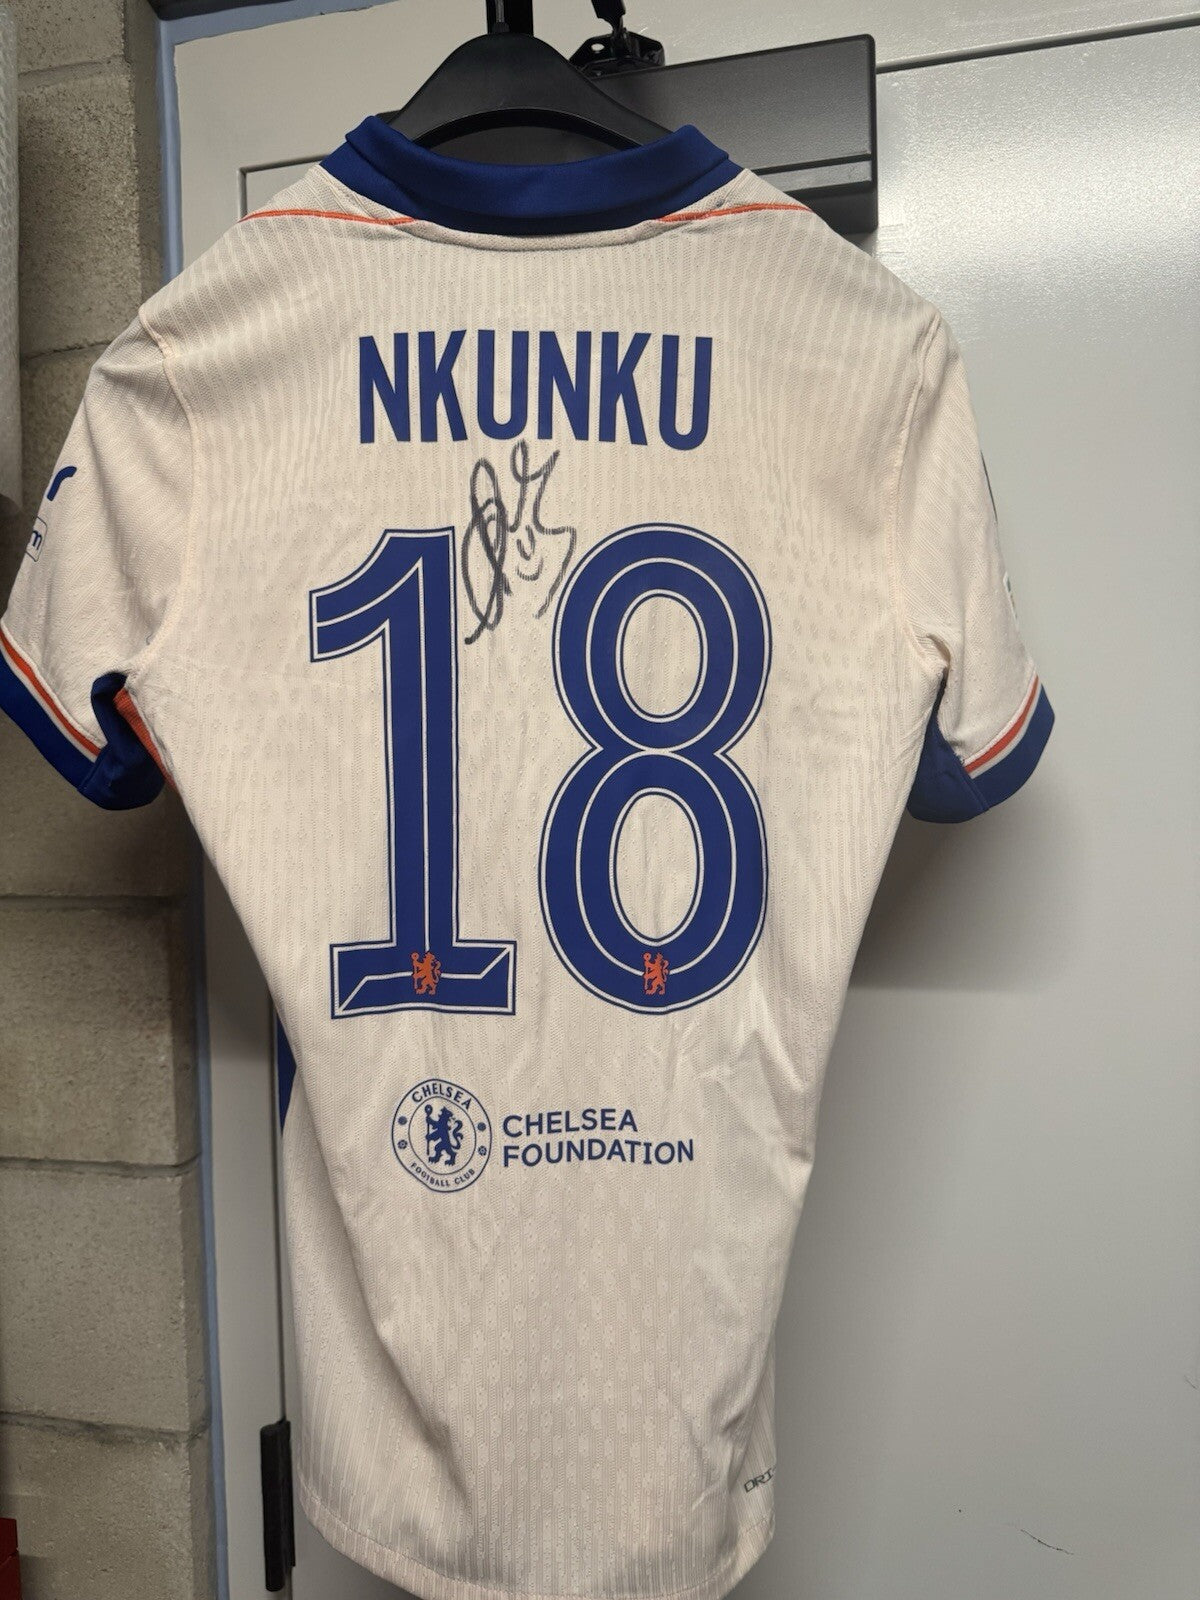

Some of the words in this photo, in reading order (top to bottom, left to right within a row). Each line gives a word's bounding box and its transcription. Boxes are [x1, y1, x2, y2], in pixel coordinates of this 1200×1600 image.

[359, 329, 713, 450] NKUNKU
[310, 522, 773, 1017] 18
[411, 1083, 473, 1111] CHELSEA
[503, 1109, 638, 1138] CHELSEA
[503, 1138, 695, 1168] FOUNDATION
[410, 1162, 451, 1187] FOOTBALL
[454, 1169, 476, 1185] CLUB
